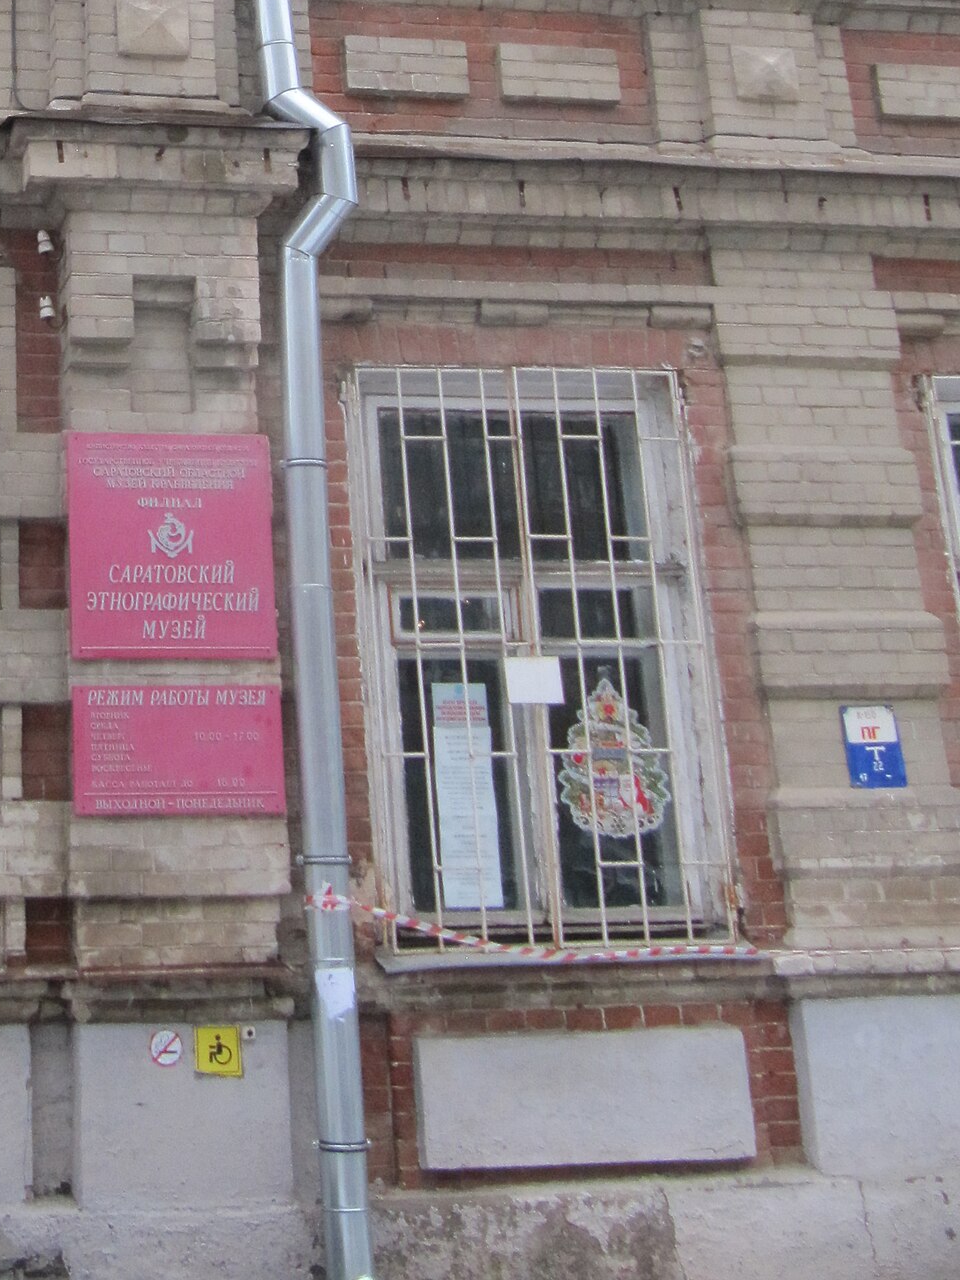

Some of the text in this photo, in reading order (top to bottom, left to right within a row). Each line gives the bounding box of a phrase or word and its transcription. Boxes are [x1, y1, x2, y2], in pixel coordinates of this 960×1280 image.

[93, 466, 176, 479] САРАТОВСКИЙ
[106, 478, 147, 489] МУЗЕЙ
[137, 497, 203, 509] ФИЛИАЛ
[109, 560, 236, 584] САРАТОВСКИЙ
[87, 588, 260, 612] ЭТНОГРАФИЧЕСКИЙ
[142, 615, 207, 640] МУЗЕЙ
[87, 690, 266, 706] РЕЖИМ РАБОТЫ МУЗЕЯ
[90, 721, 120, 730] СРЕДА
[873, 761, 885, 771] 22
[95, 798, 166, 810] ВЫХОДНОЙ
[176, 797, 265, 810] ПОНЕДЕЛЬНИК
